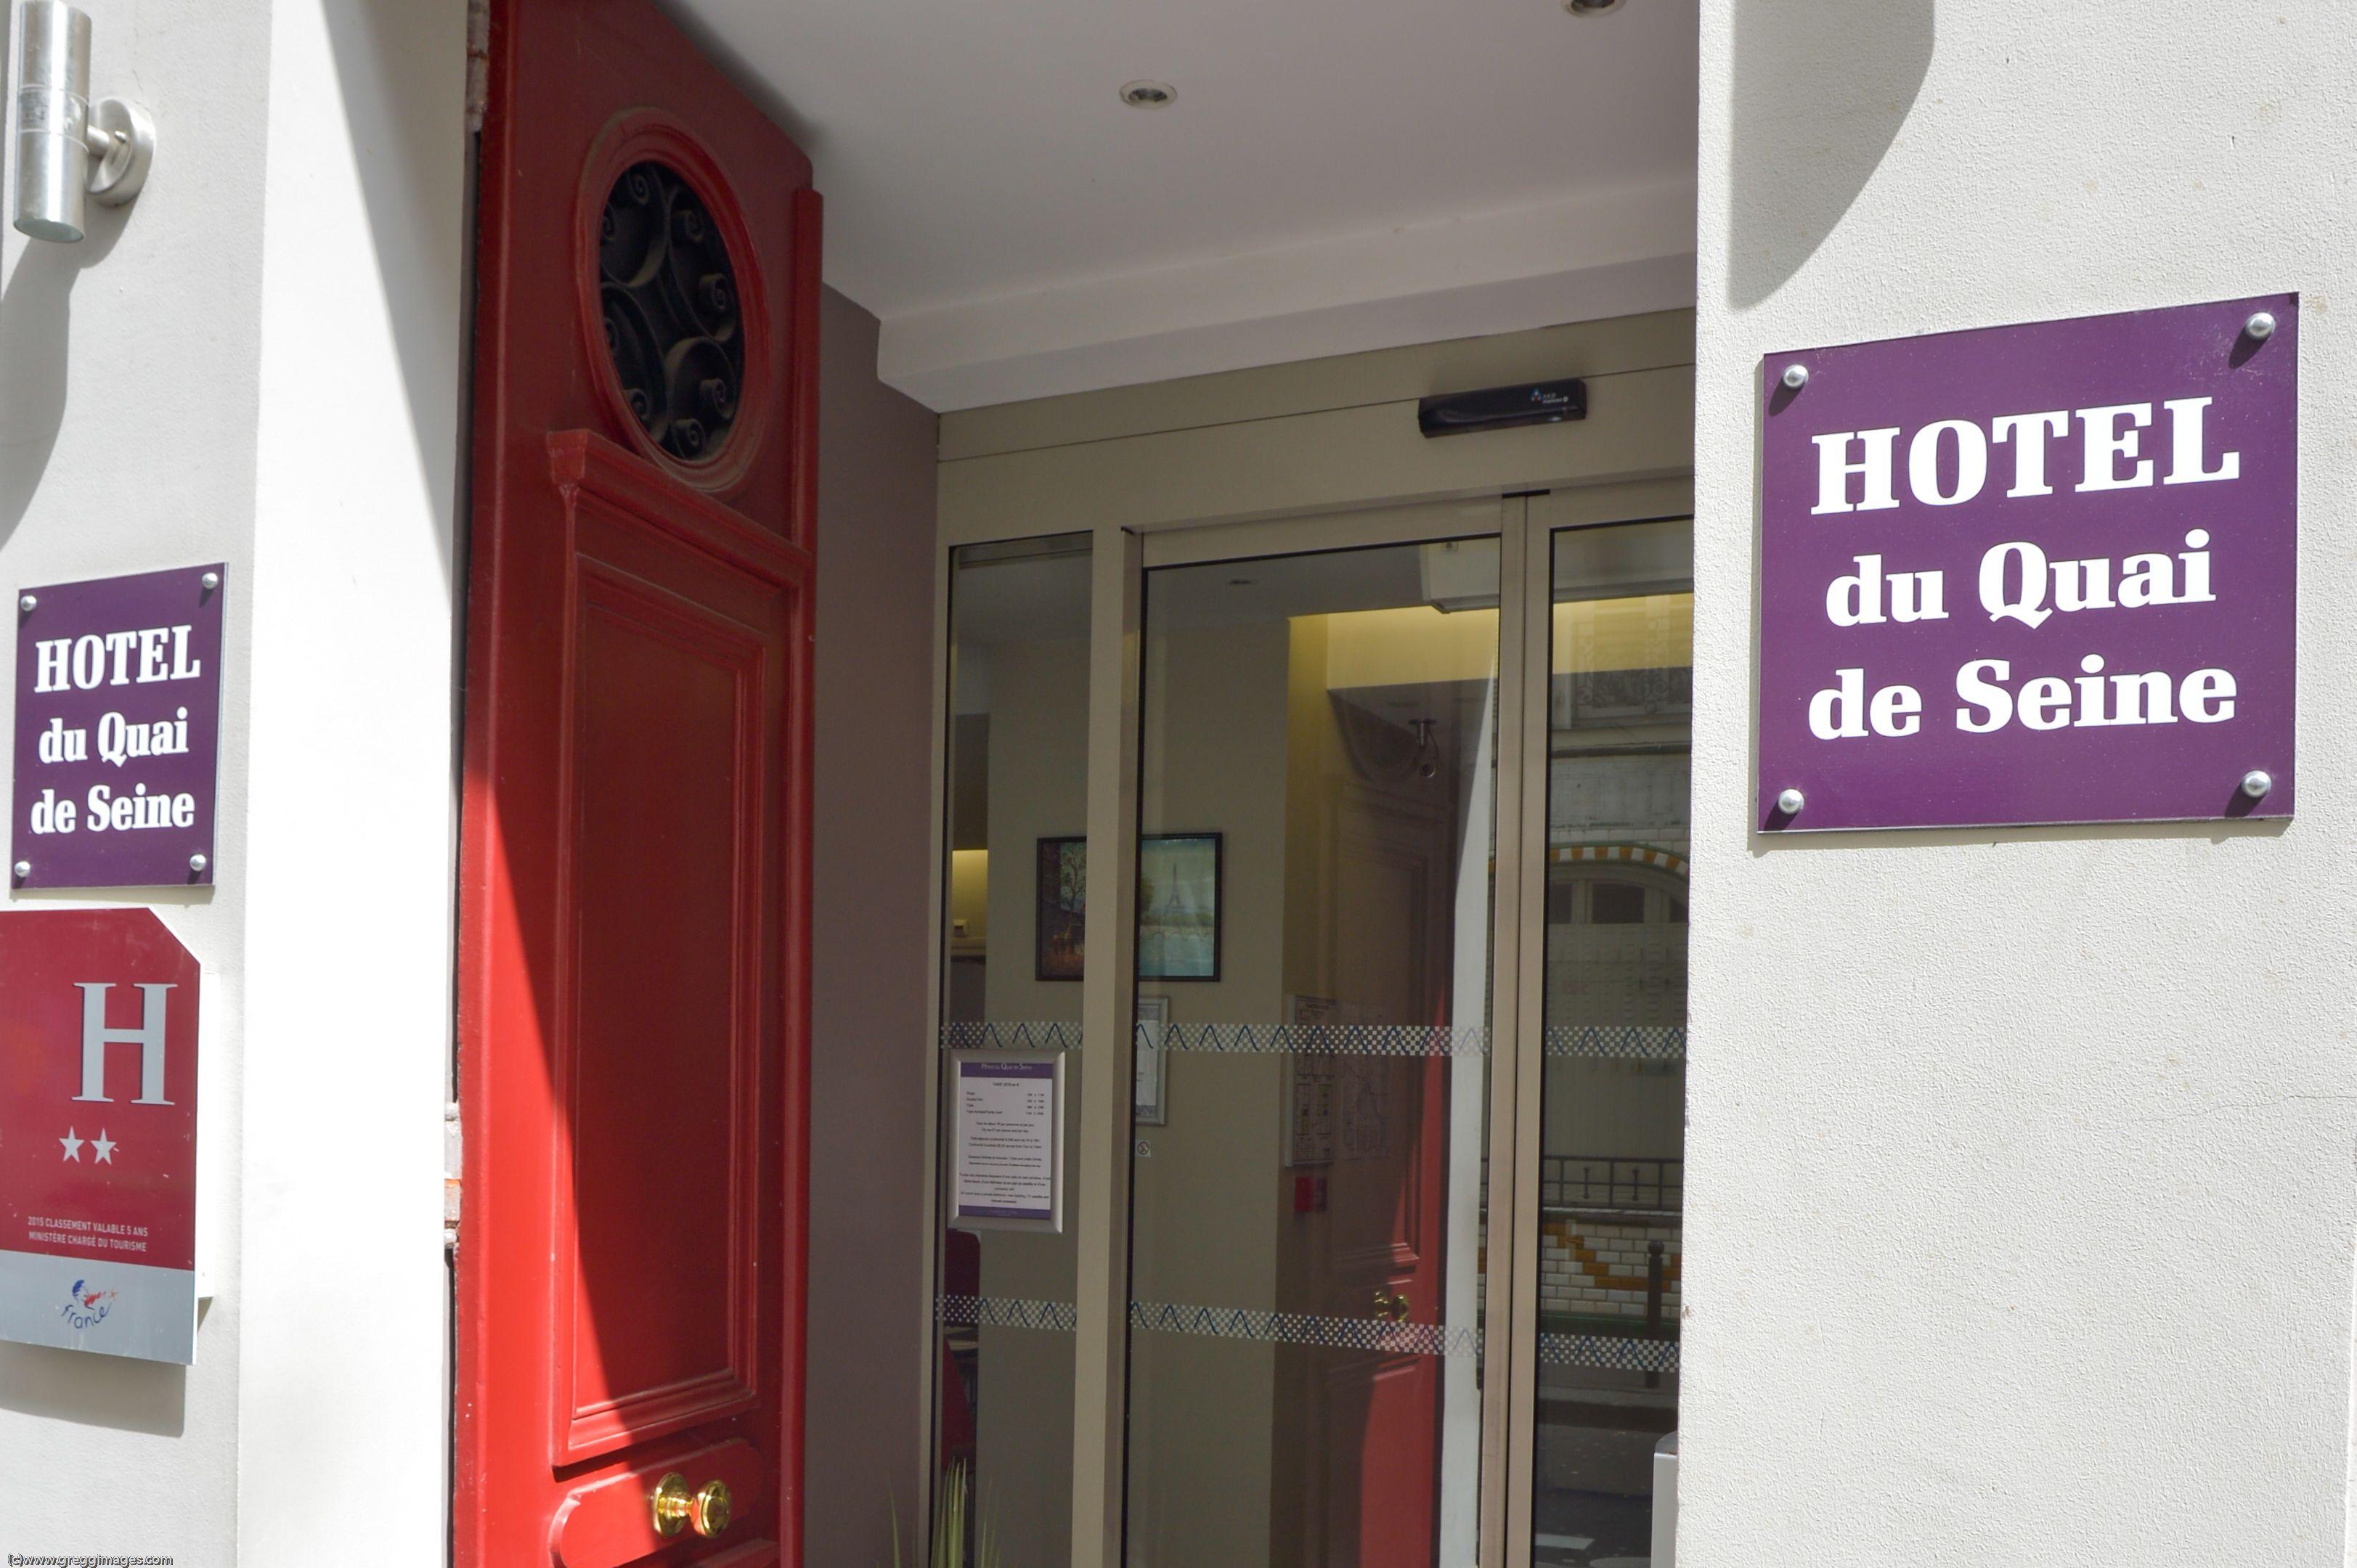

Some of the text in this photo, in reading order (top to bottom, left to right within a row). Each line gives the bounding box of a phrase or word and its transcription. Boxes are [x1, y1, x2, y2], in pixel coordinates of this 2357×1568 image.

[1810, 396, 2239, 515] HOTEL
[1825, 528, 2216, 629] du Quai
[34, 625, 200, 693] HOTEL
[1808, 654, 2237, 740] de Seine
[38, 706, 189, 767] du Quai
[30, 783, 195, 834] de Seine
[72, 982, 178, 1106] H
[28, 1216, 148, 1237] 2015 CLASSEMENT VALABLE 5 ANS
[68, 1234, 96, 1247] CHARGÉ
[98, 1239, 108, 1248] DU
[110, 1239, 147, 1251] TOURISME
